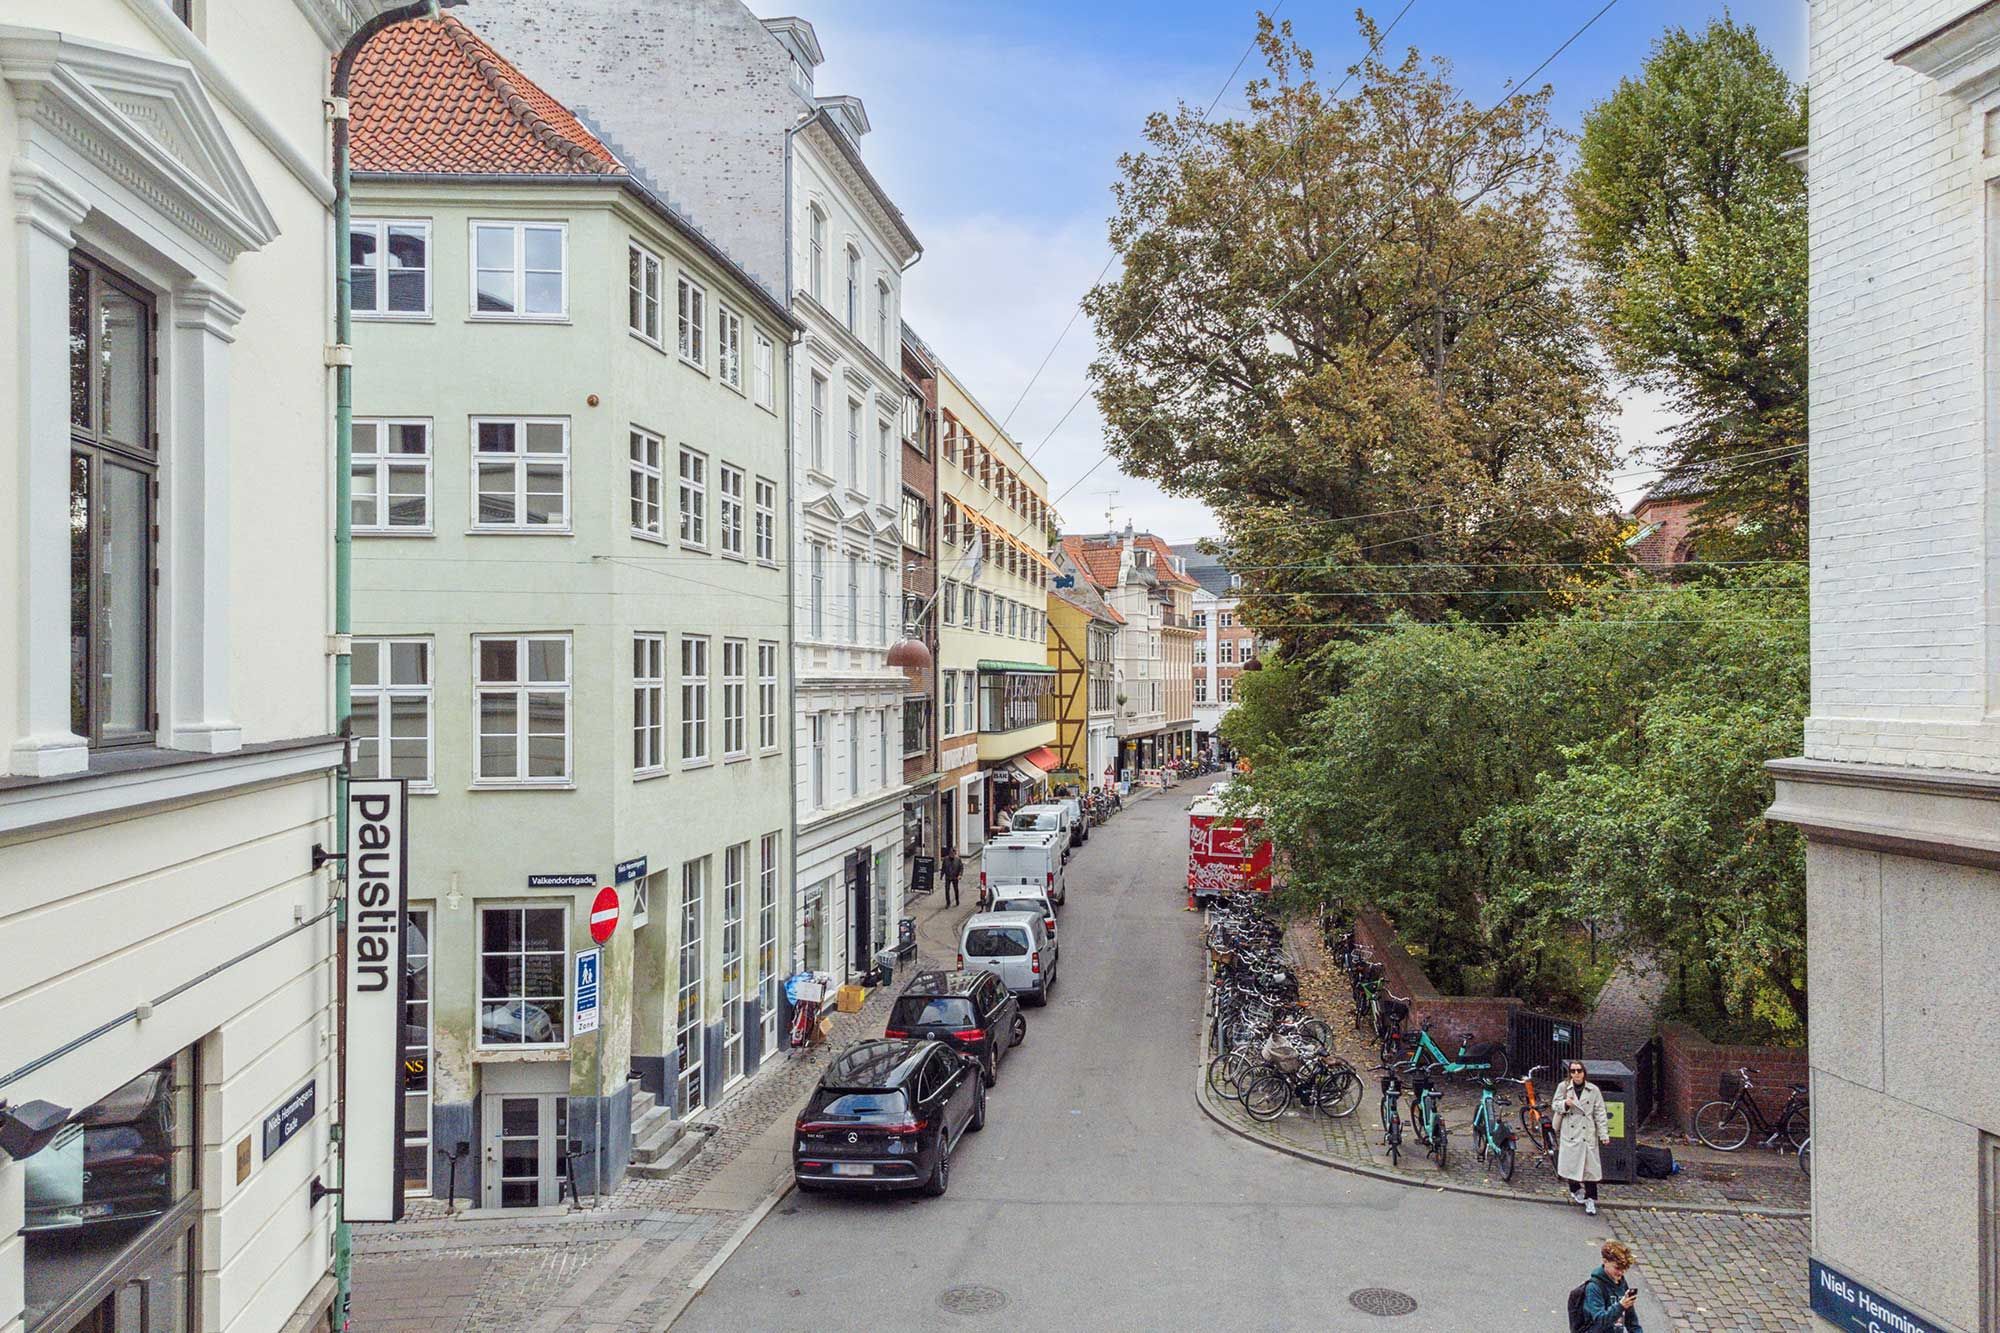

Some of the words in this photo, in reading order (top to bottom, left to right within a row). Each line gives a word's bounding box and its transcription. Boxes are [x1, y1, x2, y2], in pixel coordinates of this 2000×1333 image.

[531, 875, 593, 886] Valkendorfsgade
[351, 794, 397, 992] paustian
[578, 1021, 594, 1031] Zone
[1820, 1269, 1855, 1303] Niels
